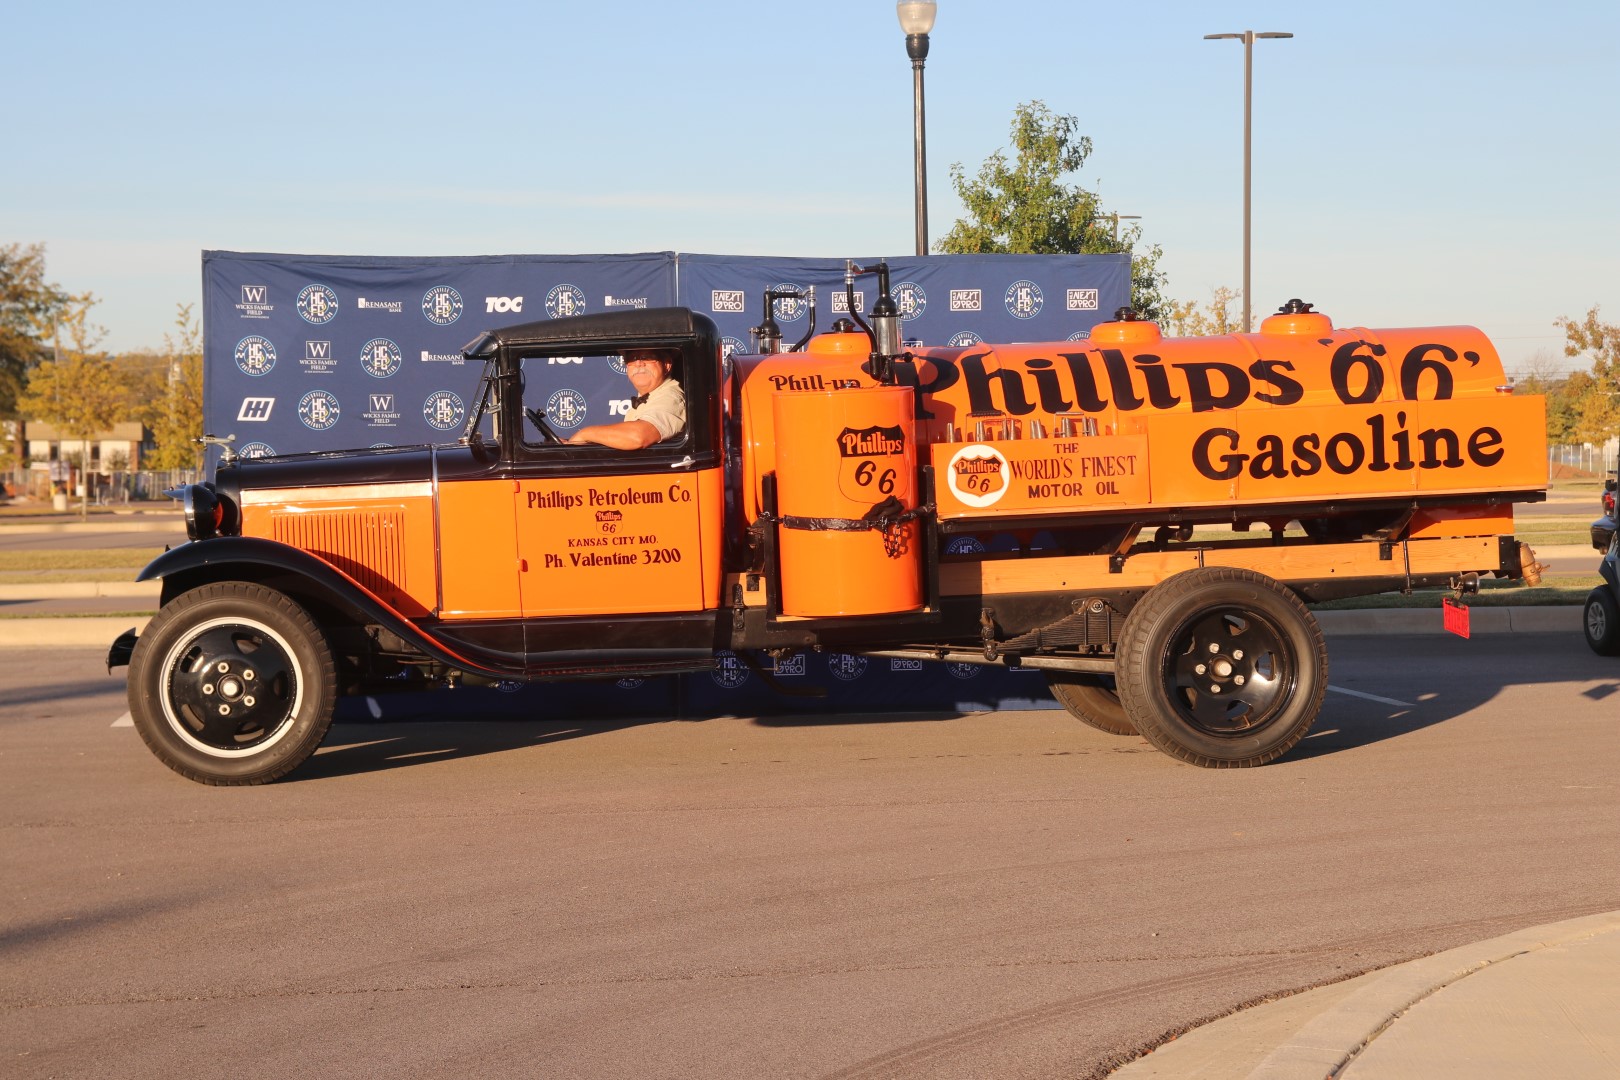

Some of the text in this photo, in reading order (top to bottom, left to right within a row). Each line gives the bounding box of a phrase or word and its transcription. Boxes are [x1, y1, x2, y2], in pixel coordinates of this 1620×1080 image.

[244, 287, 264, 302] W
[311, 292, 324, 305] HC
[436, 293, 449, 306] HC
[559, 292, 571, 304] HC
[719, 293, 741, 301] NEXT
[838, 293, 861, 302] NT
[901, 290, 913, 303] HC
[957, 291, 979, 300] NEXT
[1018, 288, 1030, 300] HC
[1073, 291, 1095, 300] NEXT
[485, 297, 523, 313] TOC
[723, 301, 742, 310] PRO
[961, 300, 979, 308] PRO
[1078, 299, 1096, 308] PRO
[249, 343, 262, 357] HC
[308, 342, 328, 357] W
[374, 346, 387, 359] HC
[861, 349, 1304, 419] Phillips
[312, 398, 325, 411] HC
[372, 396, 391, 410] W
[437, 398, 450, 411] HC
[560, 397, 573, 409] HC
[609, 400, 632, 415] TO
[842, 432, 901, 458] Phillips
[1053, 443, 1079, 454] THE
[1192, 411, 1504, 480] Gasoline
[955, 458, 1000, 474] Phillips
[1010, 455, 1137, 480] WORLD'S FINEST
[855, 461, 896, 494] 66
[967, 475, 990, 492] 66
[1028, 481, 1119, 498] MOTOR OIL
[527, 485, 691, 510] Phillips Petroleum Co.
[597, 511, 621, 520] Phillips
[602, 522, 616, 533] 66
[568, 538, 608, 547] KANSAS
[612, 536, 635, 545] CITY
[544, 548, 681, 568] Ph. Valentine 3200
